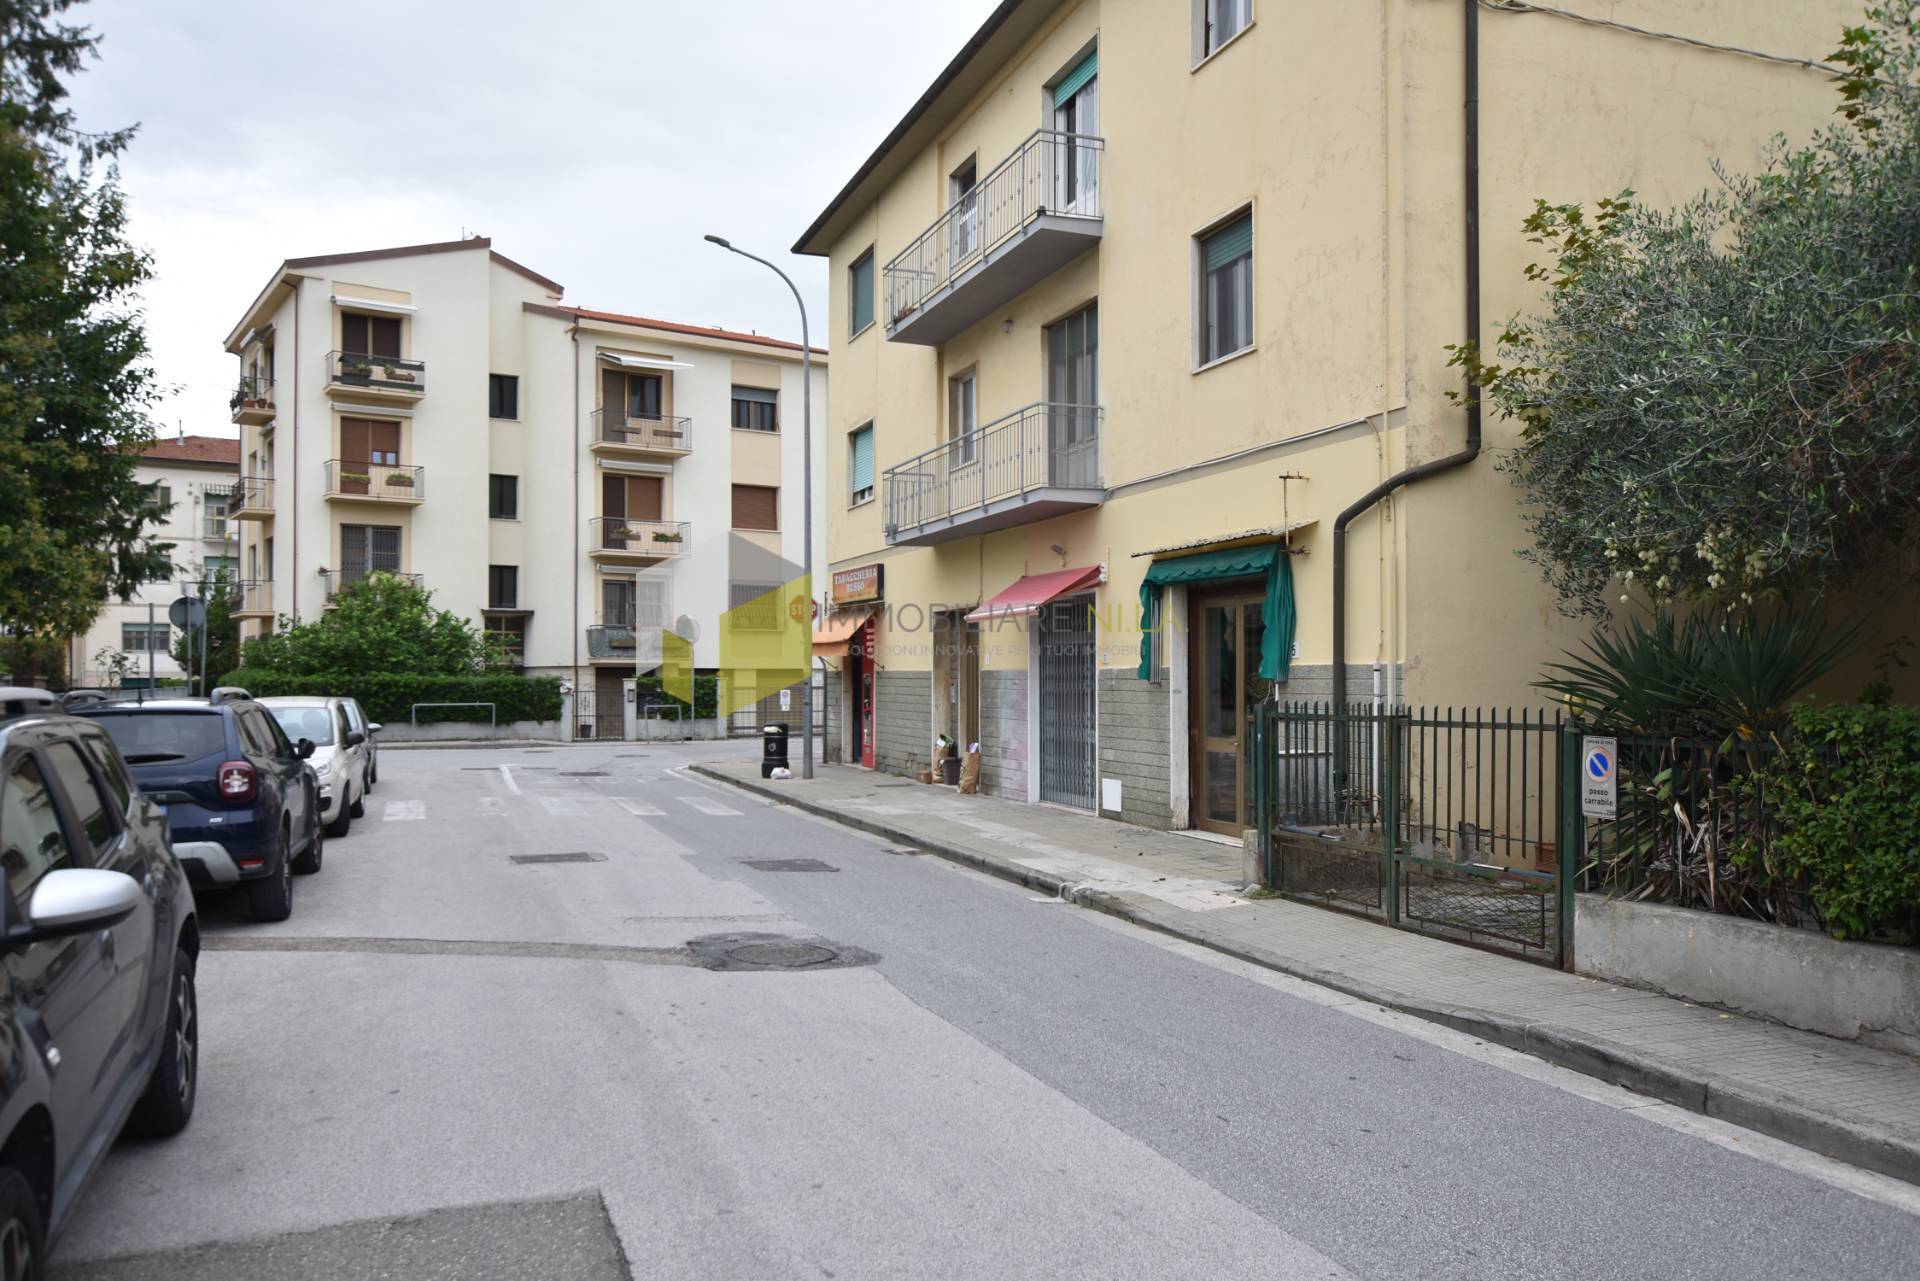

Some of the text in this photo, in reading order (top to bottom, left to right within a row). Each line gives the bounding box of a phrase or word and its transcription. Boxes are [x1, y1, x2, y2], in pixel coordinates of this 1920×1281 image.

[834, 568, 877, 584] TABACCHERIA
[1589, 788, 1608, 796] passo
[1584, 798, 1613, 807] carrabile
